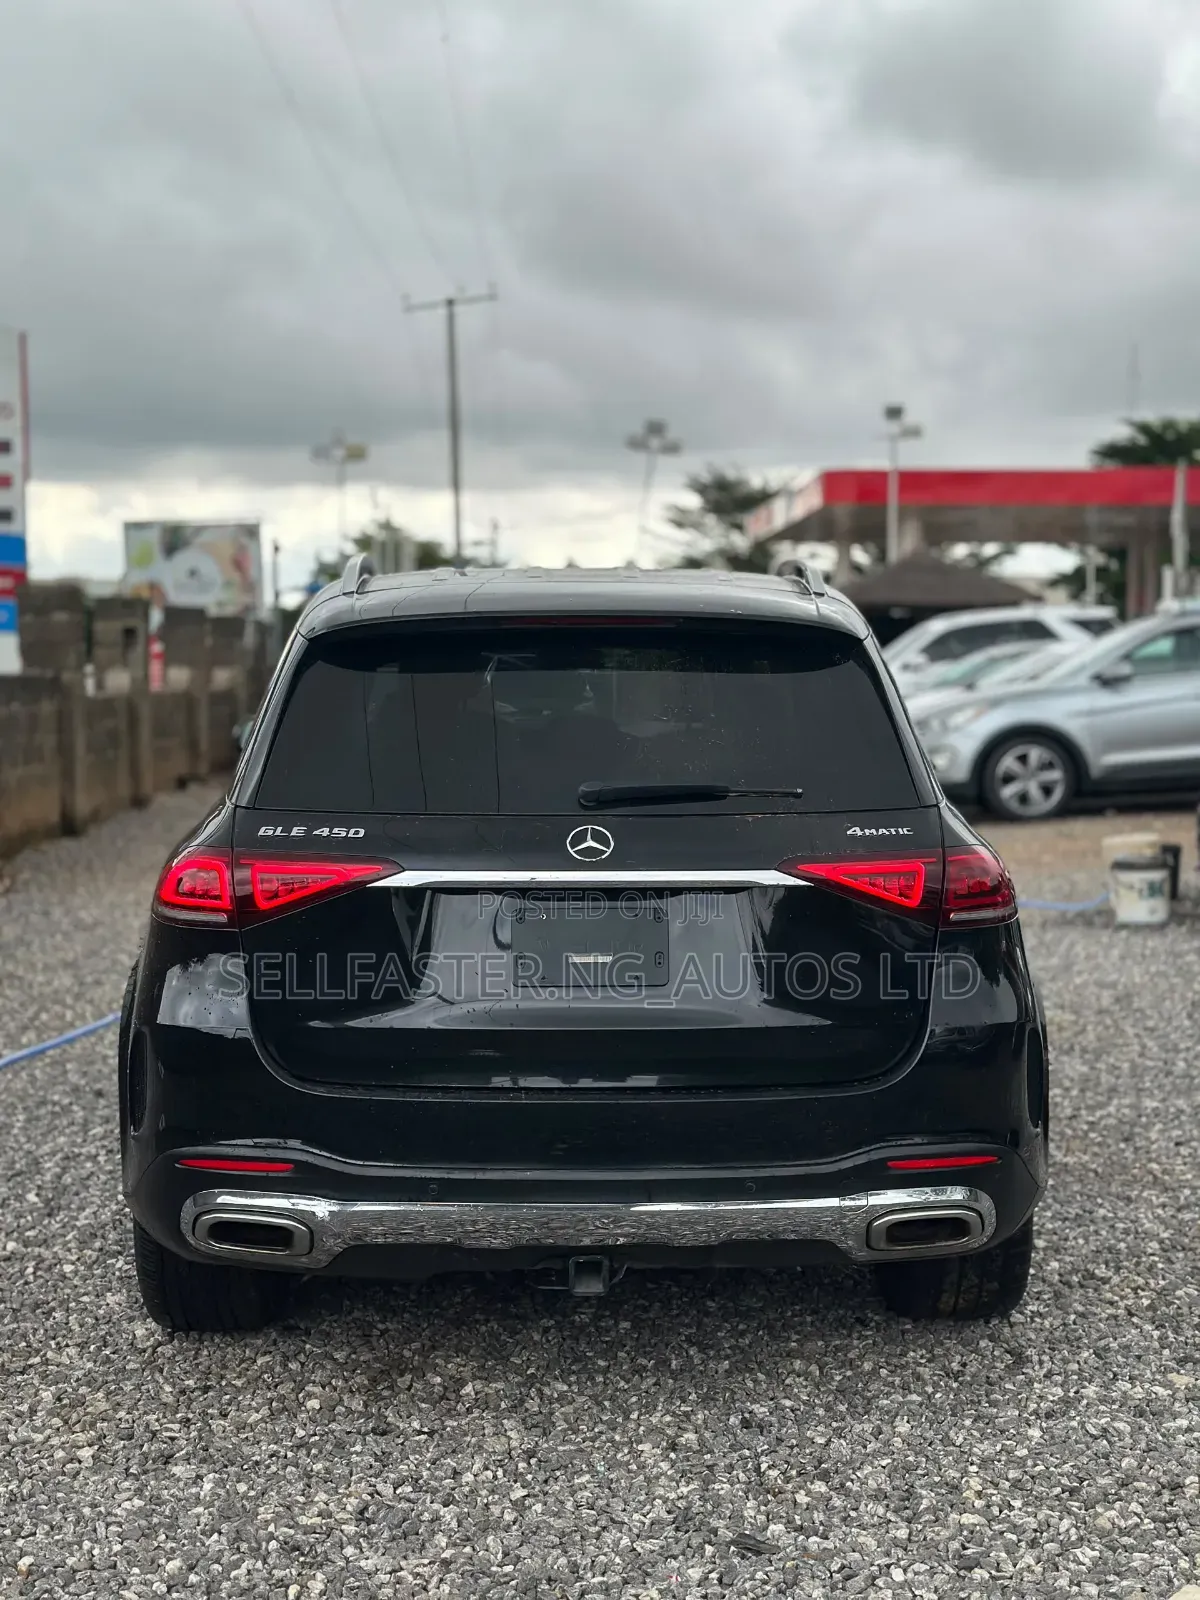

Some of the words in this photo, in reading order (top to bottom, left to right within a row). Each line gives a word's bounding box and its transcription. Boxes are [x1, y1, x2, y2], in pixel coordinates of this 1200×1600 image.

[257, 826, 307, 837] GLE
[312, 827, 365, 838] 450
[846, 826, 914, 837] 4MATIC
